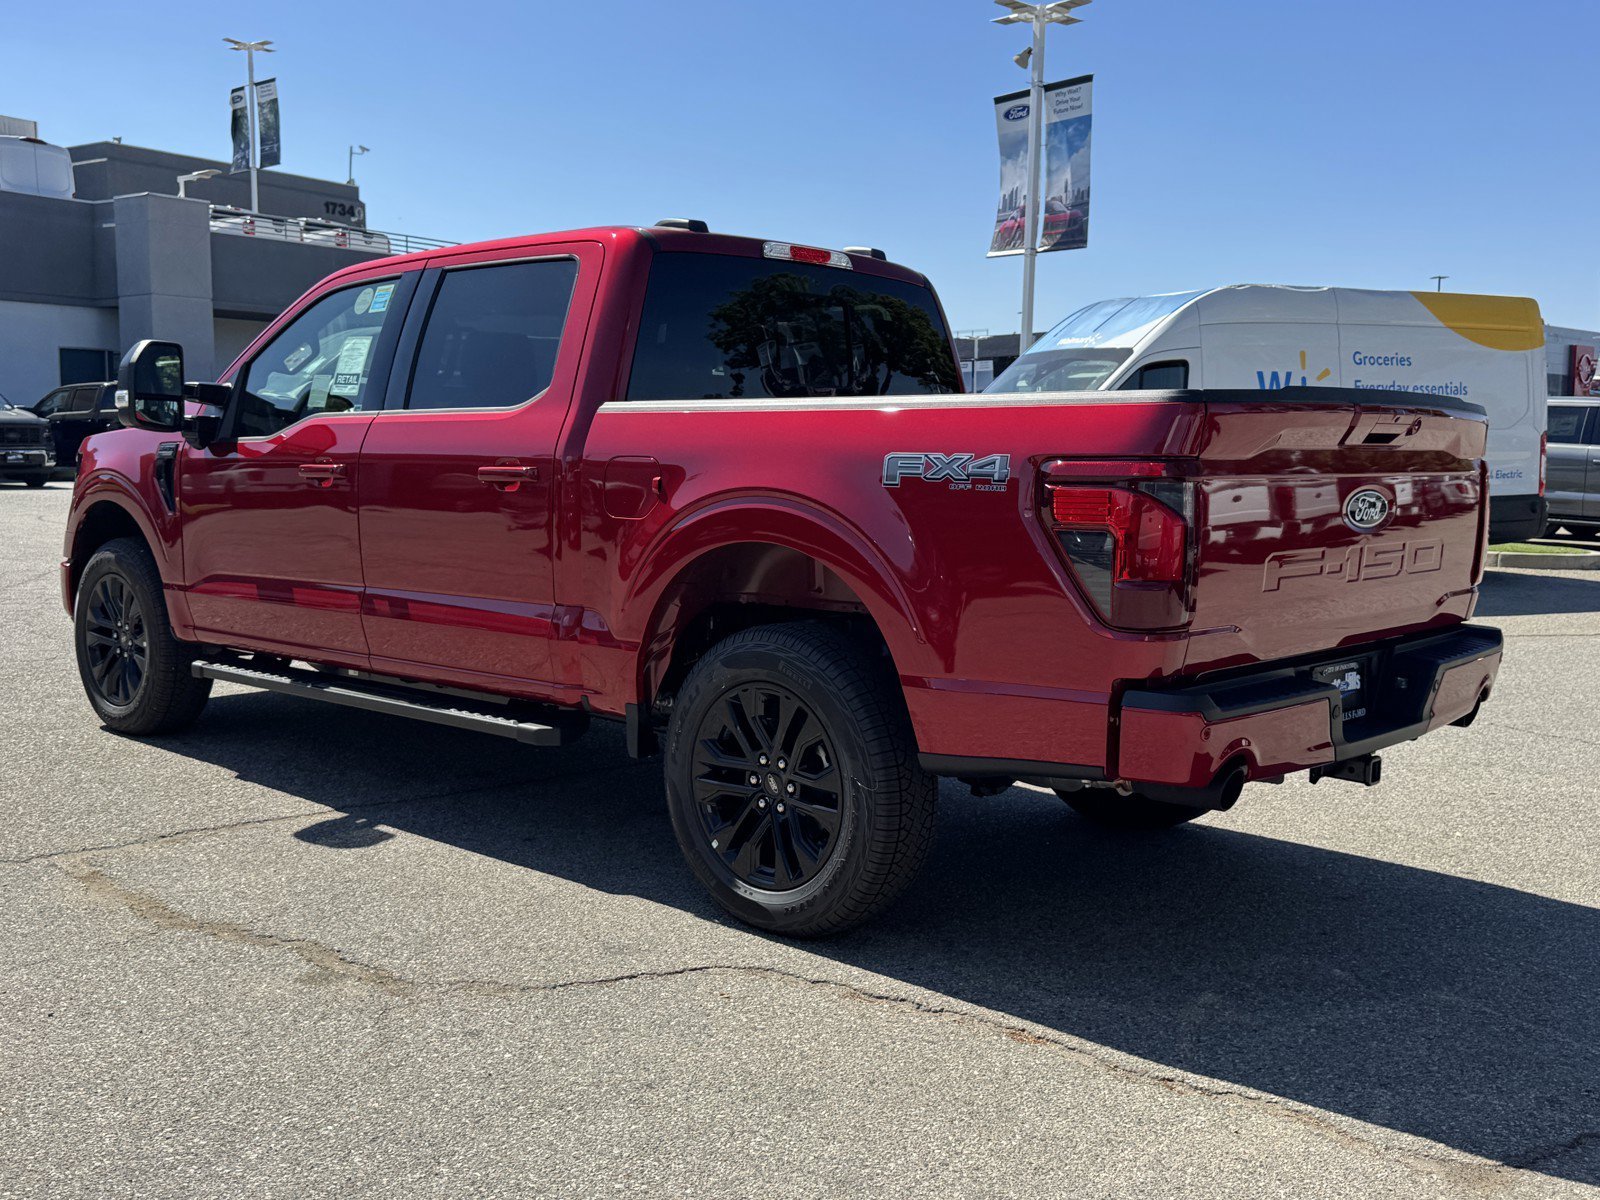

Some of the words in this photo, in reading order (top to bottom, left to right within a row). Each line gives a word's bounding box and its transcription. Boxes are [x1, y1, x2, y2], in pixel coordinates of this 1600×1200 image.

[1055, 90, 1067, 98] Why
[1067, 86, 1082, 95] Wait?
[1056, 98, 1069, 106] Drive
[1006, 105, 1029, 120] Ford
[1053, 107, 1069, 115] Future
[1069, 103, 1084, 111] Now!
[1352, 351, 1412, 366] Groceries
[336, 374, 358, 384] RETAIL
[1412, 381, 1468, 395] essentials
[881, 451, 1010, 487] FX4
[1495, 469, 1523, 479] Electric
[975, 484, 1007, 492] ROAD
[1353, 494, 1384, 522] Ford
[1262, 538, 1445, 593] F-150
